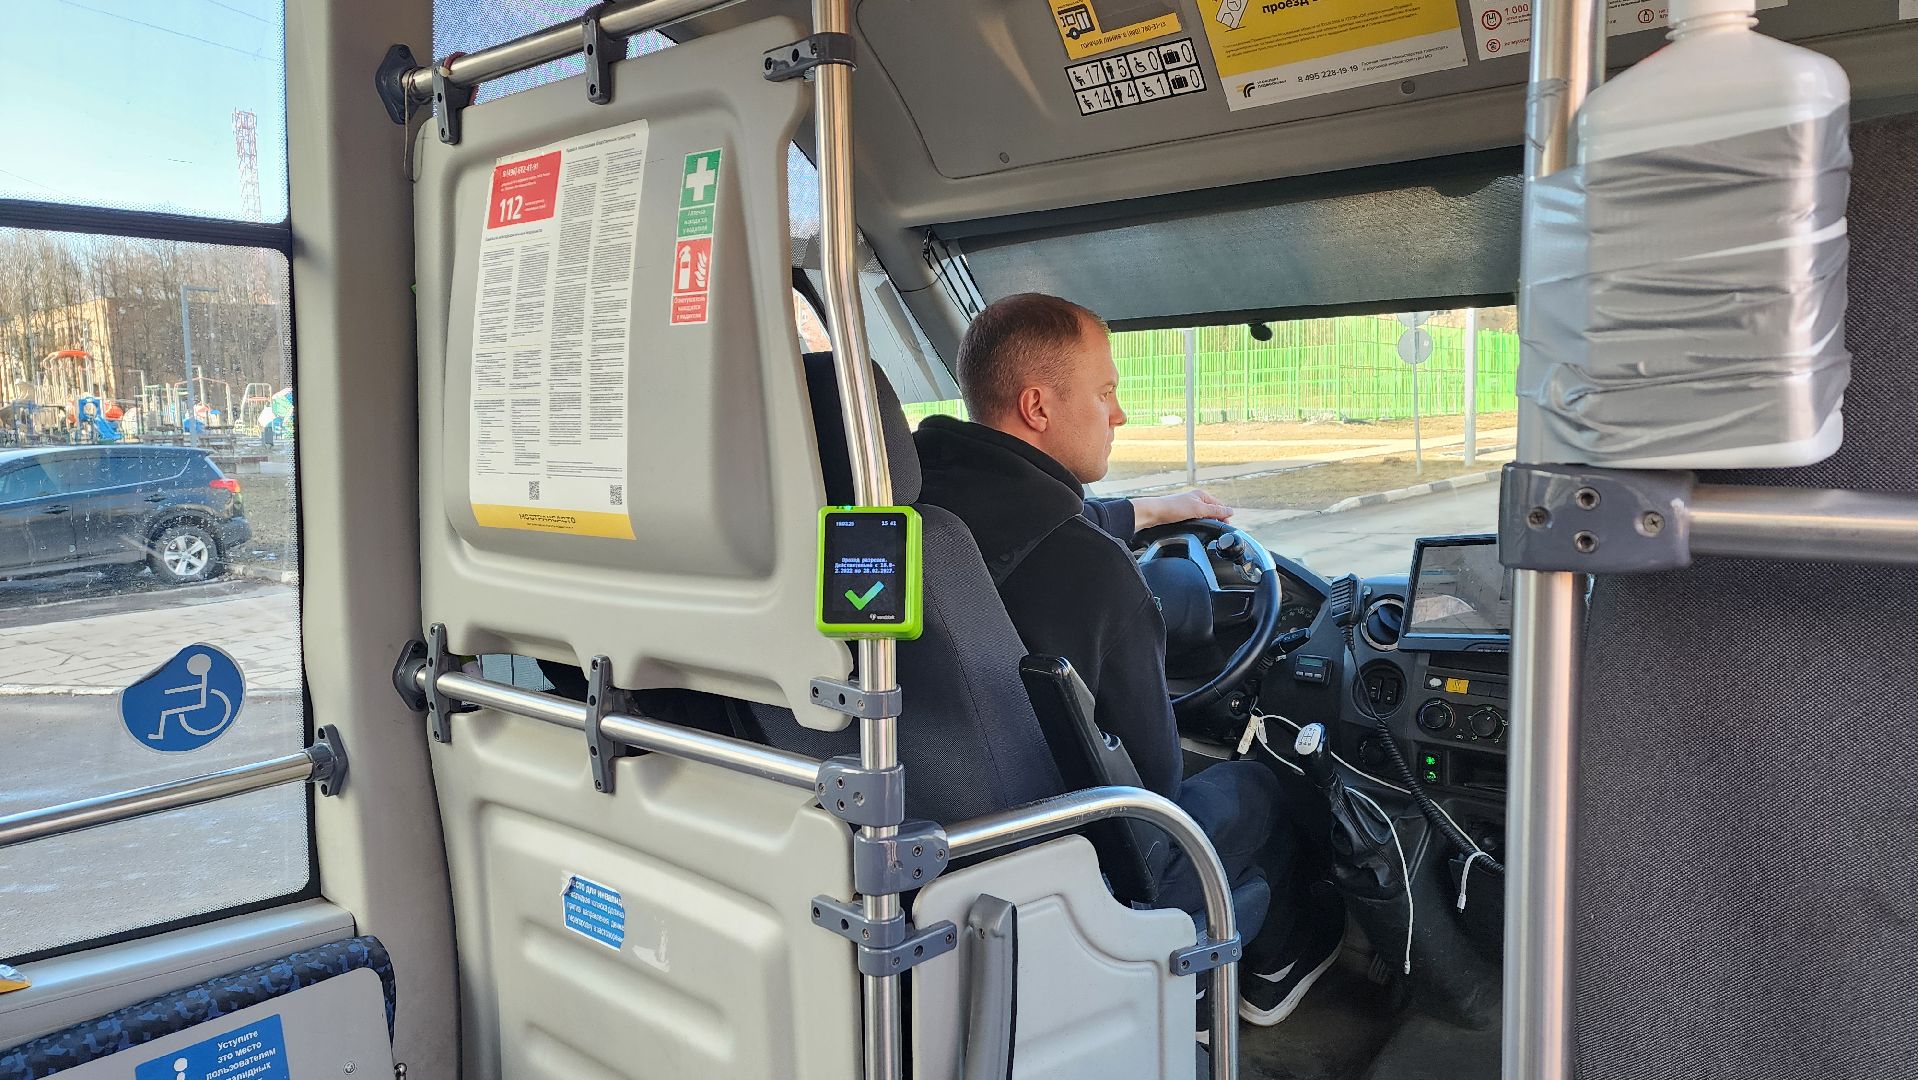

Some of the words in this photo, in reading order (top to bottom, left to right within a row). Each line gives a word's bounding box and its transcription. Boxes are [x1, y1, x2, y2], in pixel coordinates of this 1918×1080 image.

[1511, 3, 1529, 14] 000
[1085, 64, 1101, 85] 17
[1116, 58, 1127, 78] 5
[1148, 50, 1159, 71] 0
[1180, 43, 1192, 63] 0
[1297, 75, 1304, 83] 8
[1305, 72, 1320, 81] 495
[1321, 64, 1359, 78] 228-19-19
[1094, 88, 1112, 109] 14
[1127, 81, 1136, 101] 4
[1156, 75, 1166, 95] 1
[1189, 68, 1200, 88] 0
[500, 195, 523, 223] 112
[217, 1030, 259, 1051] Уступите
[217, 1052, 234, 1064] это
[235, 1041, 262, 1057] место
[206, 1048, 276, 1080] пользователям
